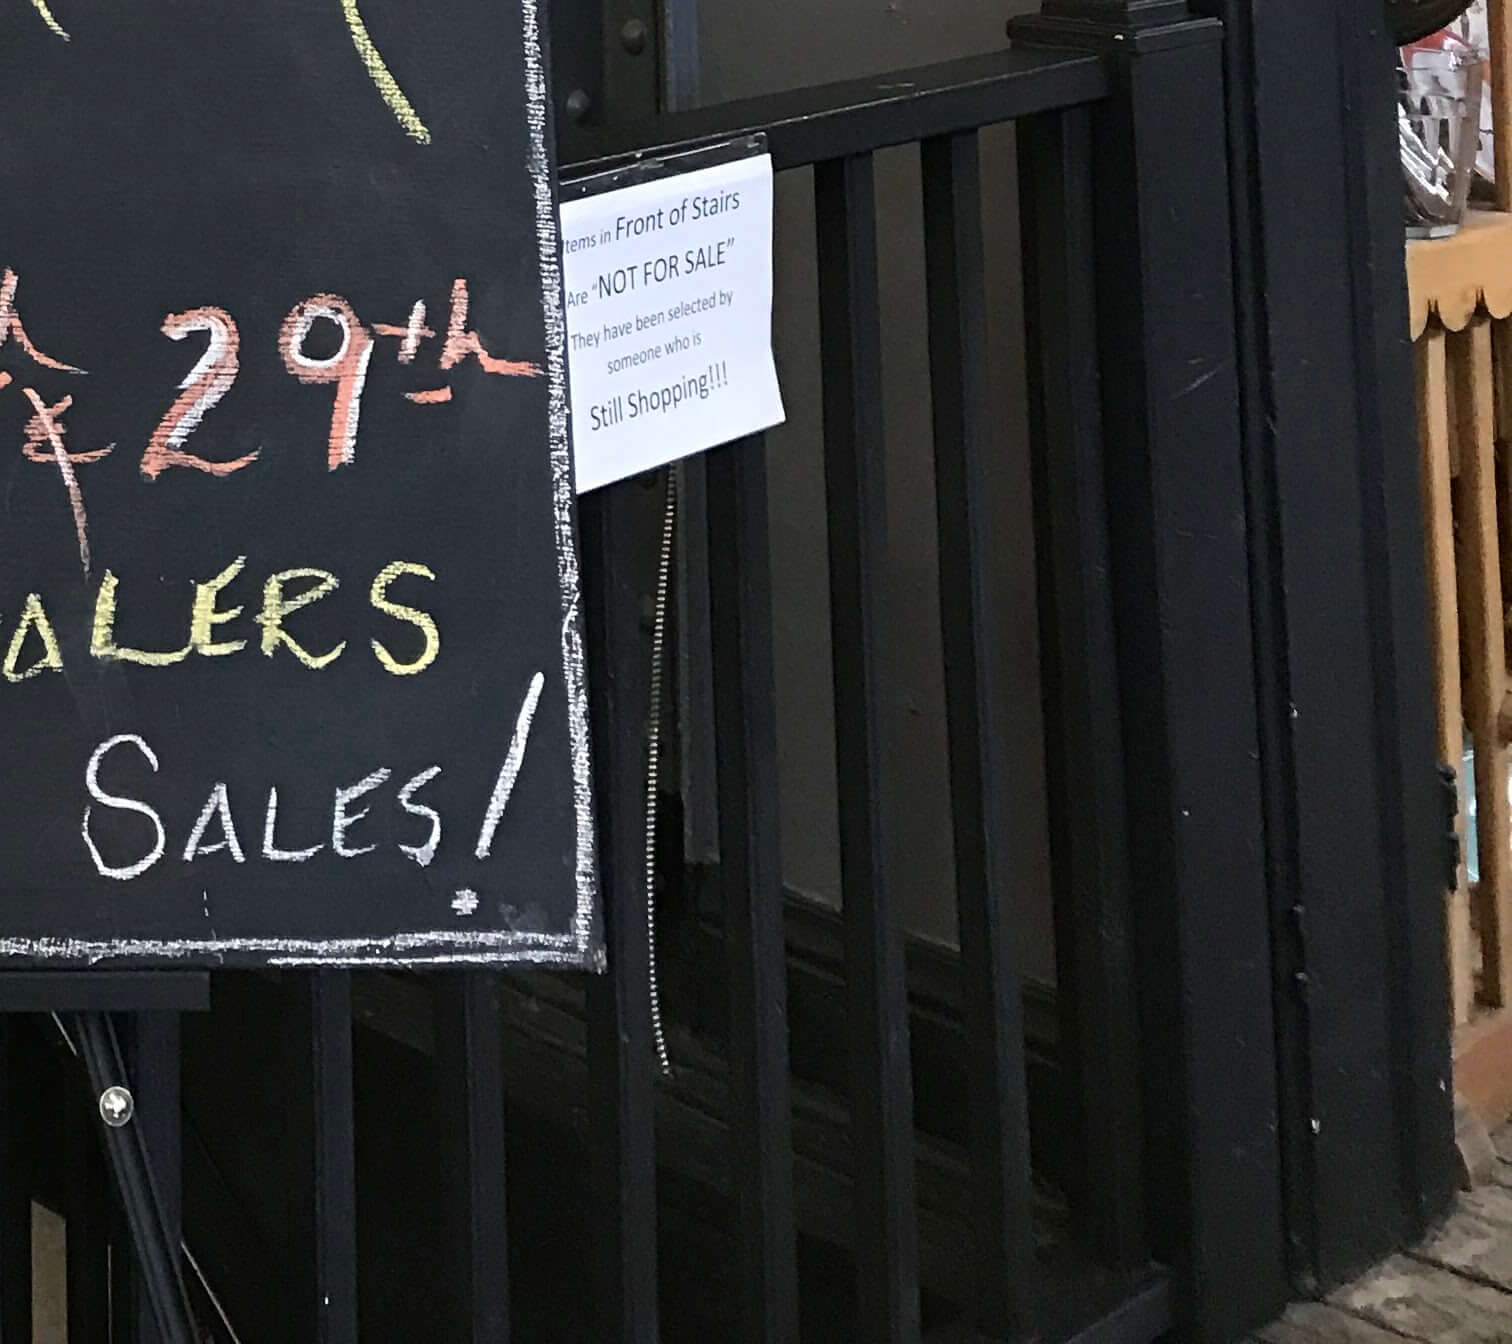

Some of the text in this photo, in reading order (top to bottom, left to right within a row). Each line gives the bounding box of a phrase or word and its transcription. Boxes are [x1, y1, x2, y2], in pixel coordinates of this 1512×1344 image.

[563, 190, 740, 255] tems in Front of Stairs
[567, 290, 588, 309] Are
[644, 255, 679, 286] FOR
[571, 289, 734, 351] They have been selected by
[139, 277, 546, 482] 29th
[607, 331, 702, 375] someone who is
[590, 361, 729, 431] Still Shopping!!!
[81, 671, 545, 917] SALES!
